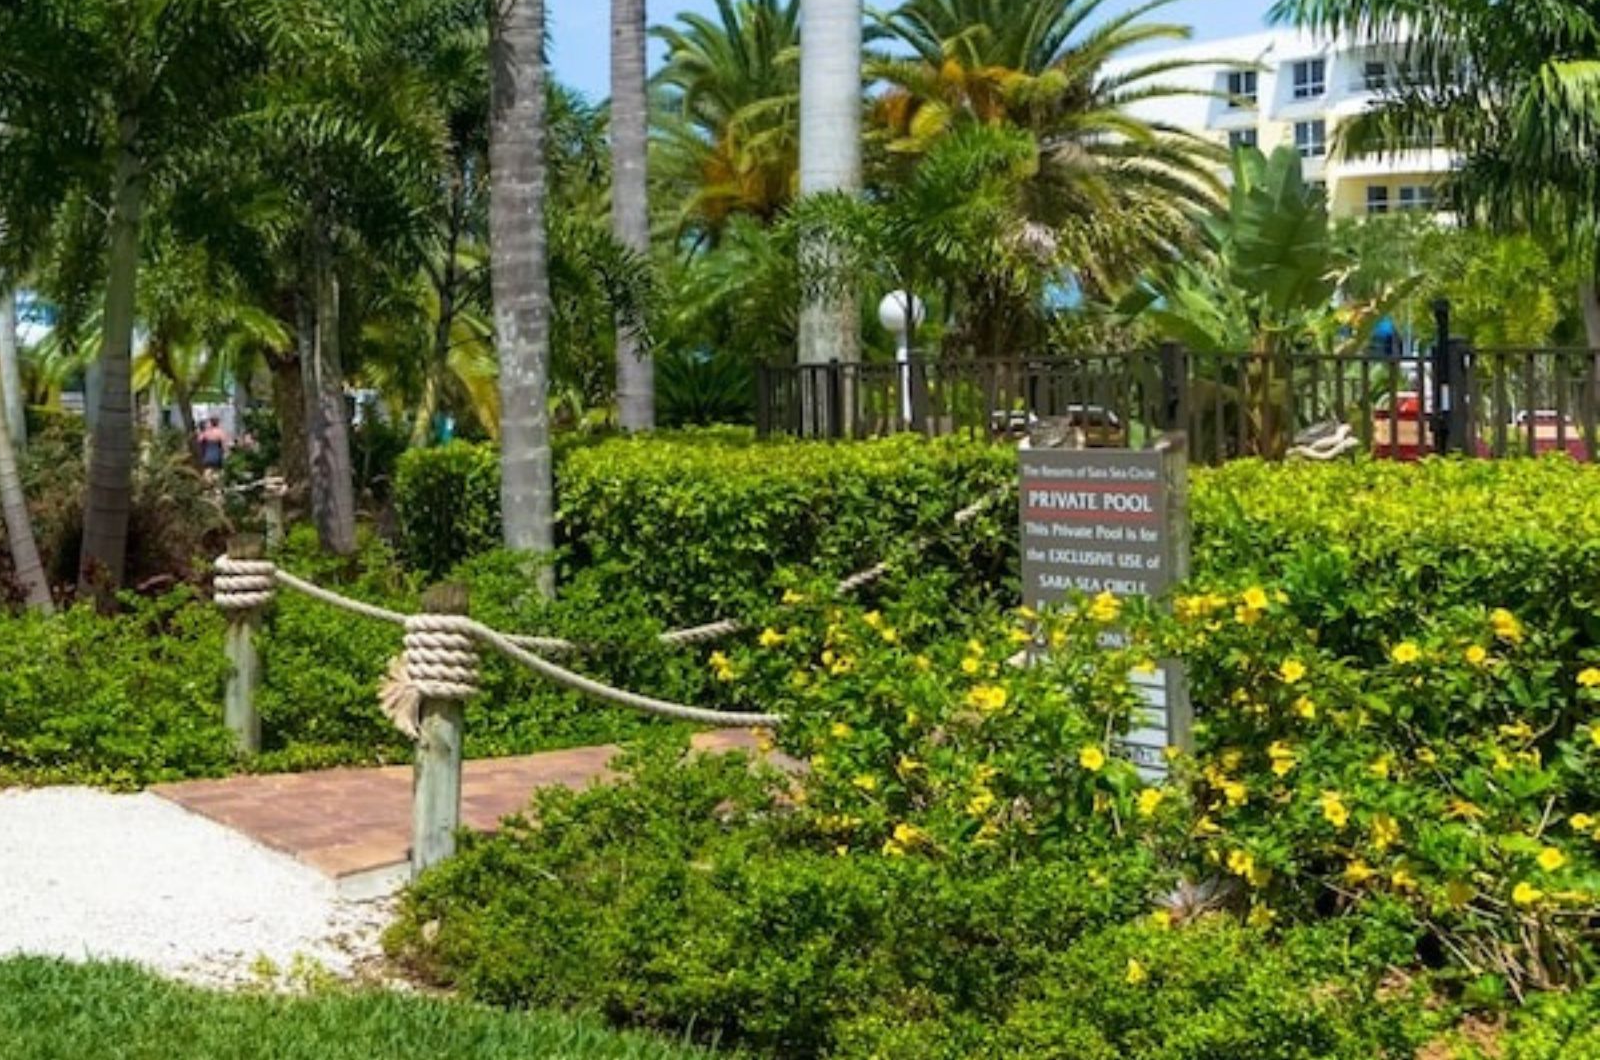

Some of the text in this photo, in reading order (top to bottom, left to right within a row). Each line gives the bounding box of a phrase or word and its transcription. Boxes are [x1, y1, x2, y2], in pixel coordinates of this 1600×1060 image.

[1110, 467, 1126, 478] Sea
[1029, 491, 1152, 512] PRIVATE POOL
[1025, 523, 1158, 542] This Private Pool is for
[1027, 550, 1161, 569] the EXCLUSIVE USE of
[1038, 575, 1147, 593] SARA SEA CIRCLE
